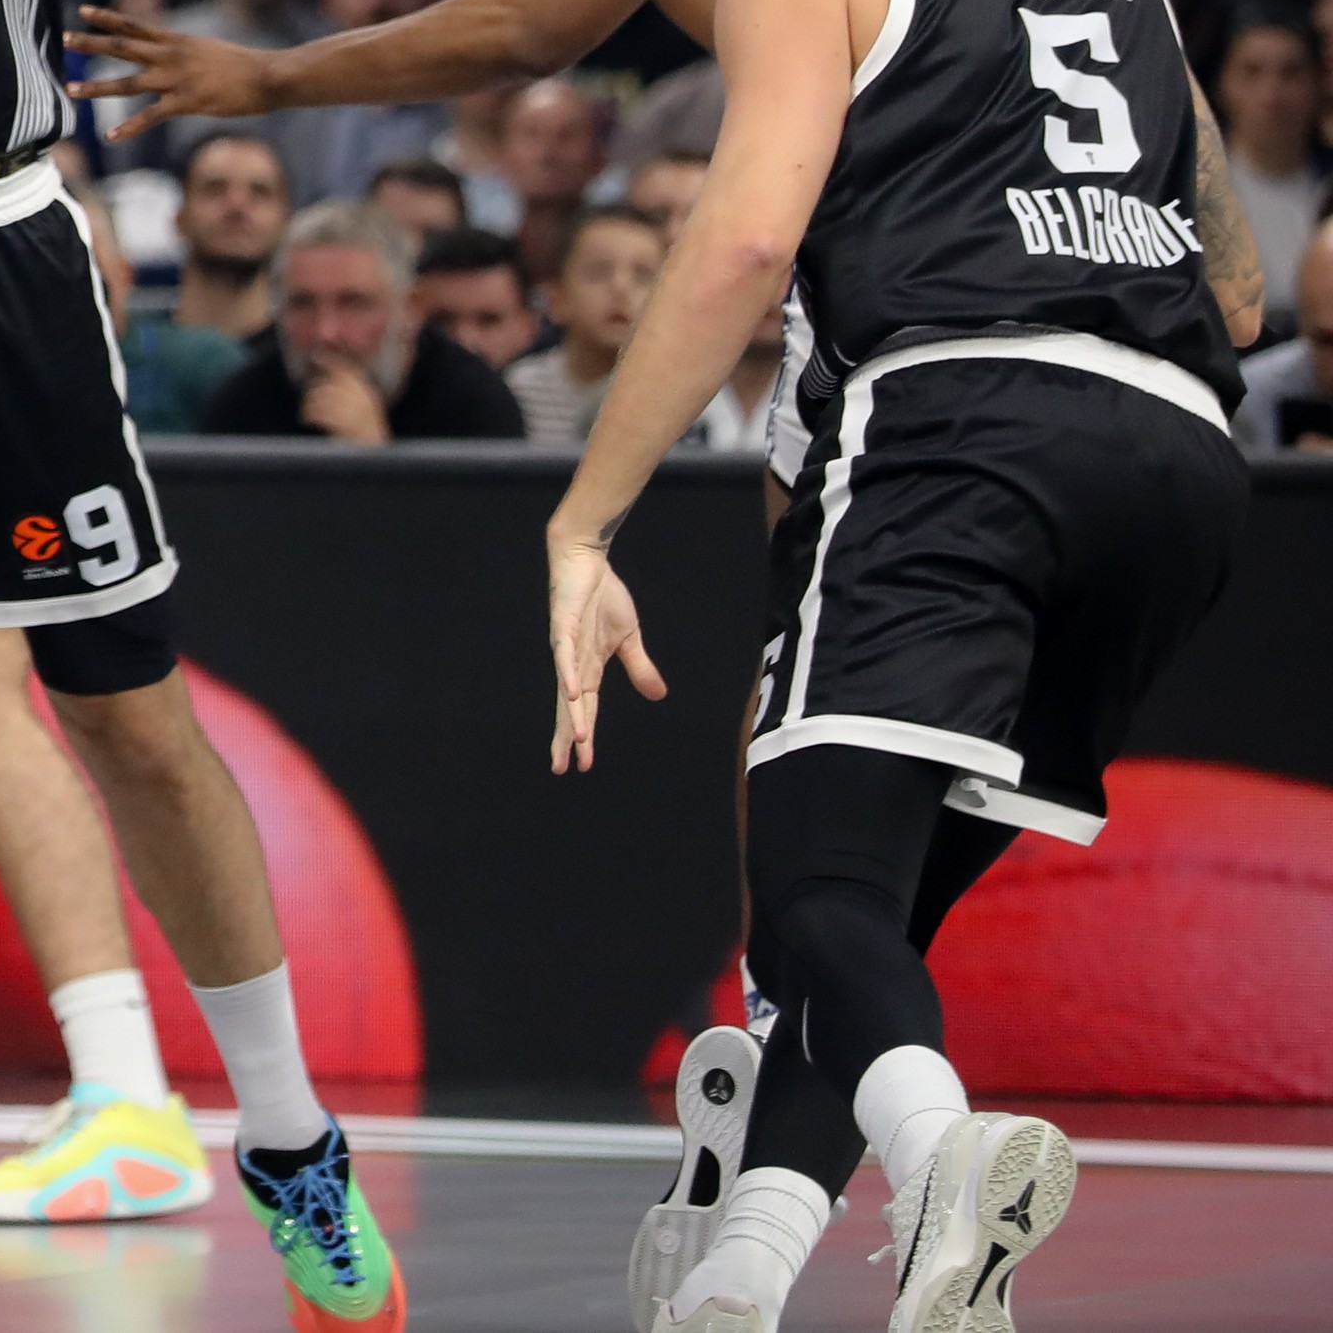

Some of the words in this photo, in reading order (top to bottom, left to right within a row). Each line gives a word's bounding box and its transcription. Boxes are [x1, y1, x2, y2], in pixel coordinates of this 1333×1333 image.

[1017, 7, 1142, 174] 5
[1006, 186, 1203, 267] BELGRADE
[63, 484, 140, 586] 9
